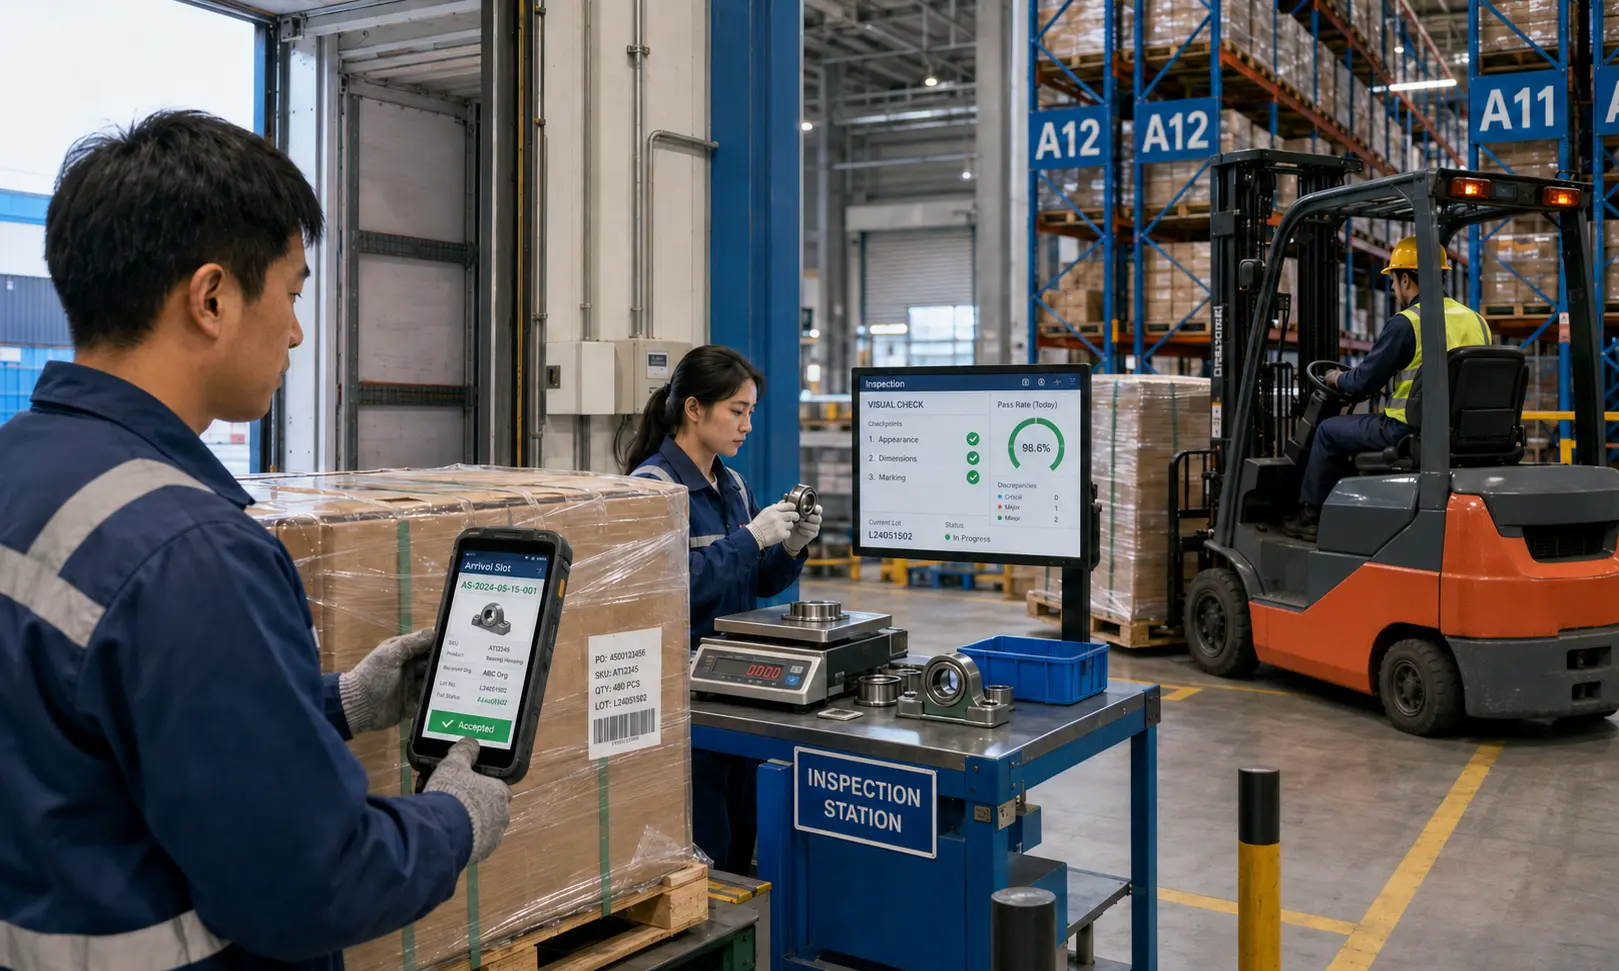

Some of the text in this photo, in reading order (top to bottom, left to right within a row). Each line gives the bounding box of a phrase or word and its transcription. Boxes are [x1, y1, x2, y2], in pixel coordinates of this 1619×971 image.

[1480, 85, 1554, 131] A11
[1142, 110, 1209, 153] A12
[1036, 118, 1100, 160] A12
[865, 380, 905, 389] Inspection
[868, 401, 924, 409] VISUAL CHECK
[998, 401, 1058, 410] Pass Rate (Today)
[868, 420, 903, 428] Checkpoints
[879, 436, 919, 444] Appearance
[1022, 443, 1051, 453] 98.6%
[879, 455, 917, 463] Dimensions
[869, 473, 907, 483] 3. Marking
[997, 482, 1037, 490] Discrepancies
[868, 531, 913, 541] L24051502
[961, 535, 991, 544] Progress
[494, 563, 511, 573] Slot
[595, 655, 608, 664] PO:
[496, 671, 508, 680] Org
[595, 670, 612, 680] SKU:
[746, 664, 781, 679] 0000
[594, 684, 612, 695] QTY:
[626, 680, 641, 690] PCS
[595, 700, 612, 711] LOT:
[458, 720, 494, 734] Accepted
[808, 768, 921, 808] INSPECTION
[824, 799, 902, 833] STATION
